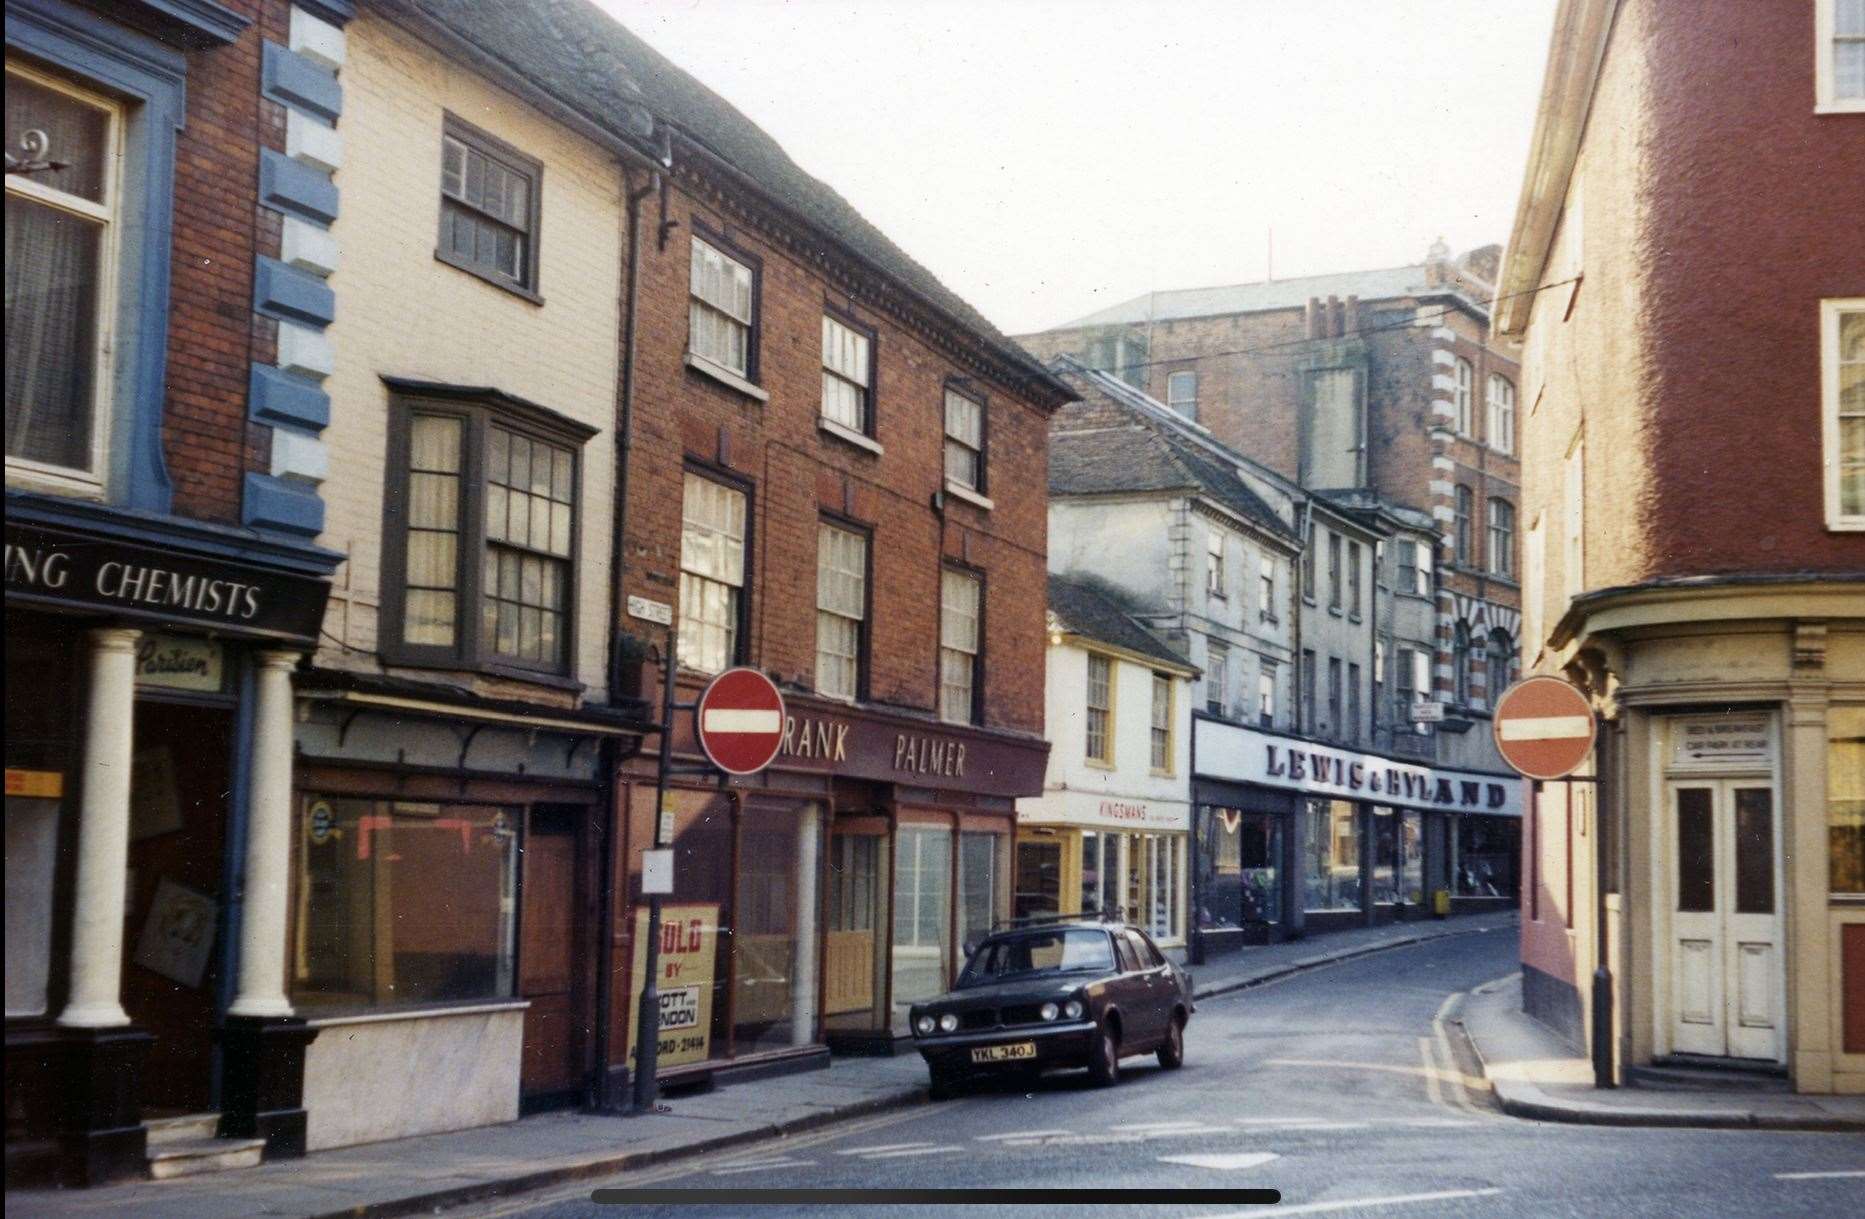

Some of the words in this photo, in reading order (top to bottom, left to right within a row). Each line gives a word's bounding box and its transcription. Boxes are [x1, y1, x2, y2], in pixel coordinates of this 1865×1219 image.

[96, 562, 262, 618] CHEMISTS
[783, 716, 849, 762] RANK
[897, 735, 966, 776] PALMER
[1267, 745, 1365, 789] LEWIS
[1386, 769, 1507, 809] HYLAND
[666, 963, 682, 978] BY
[974, 1048, 998, 1062] YKL
